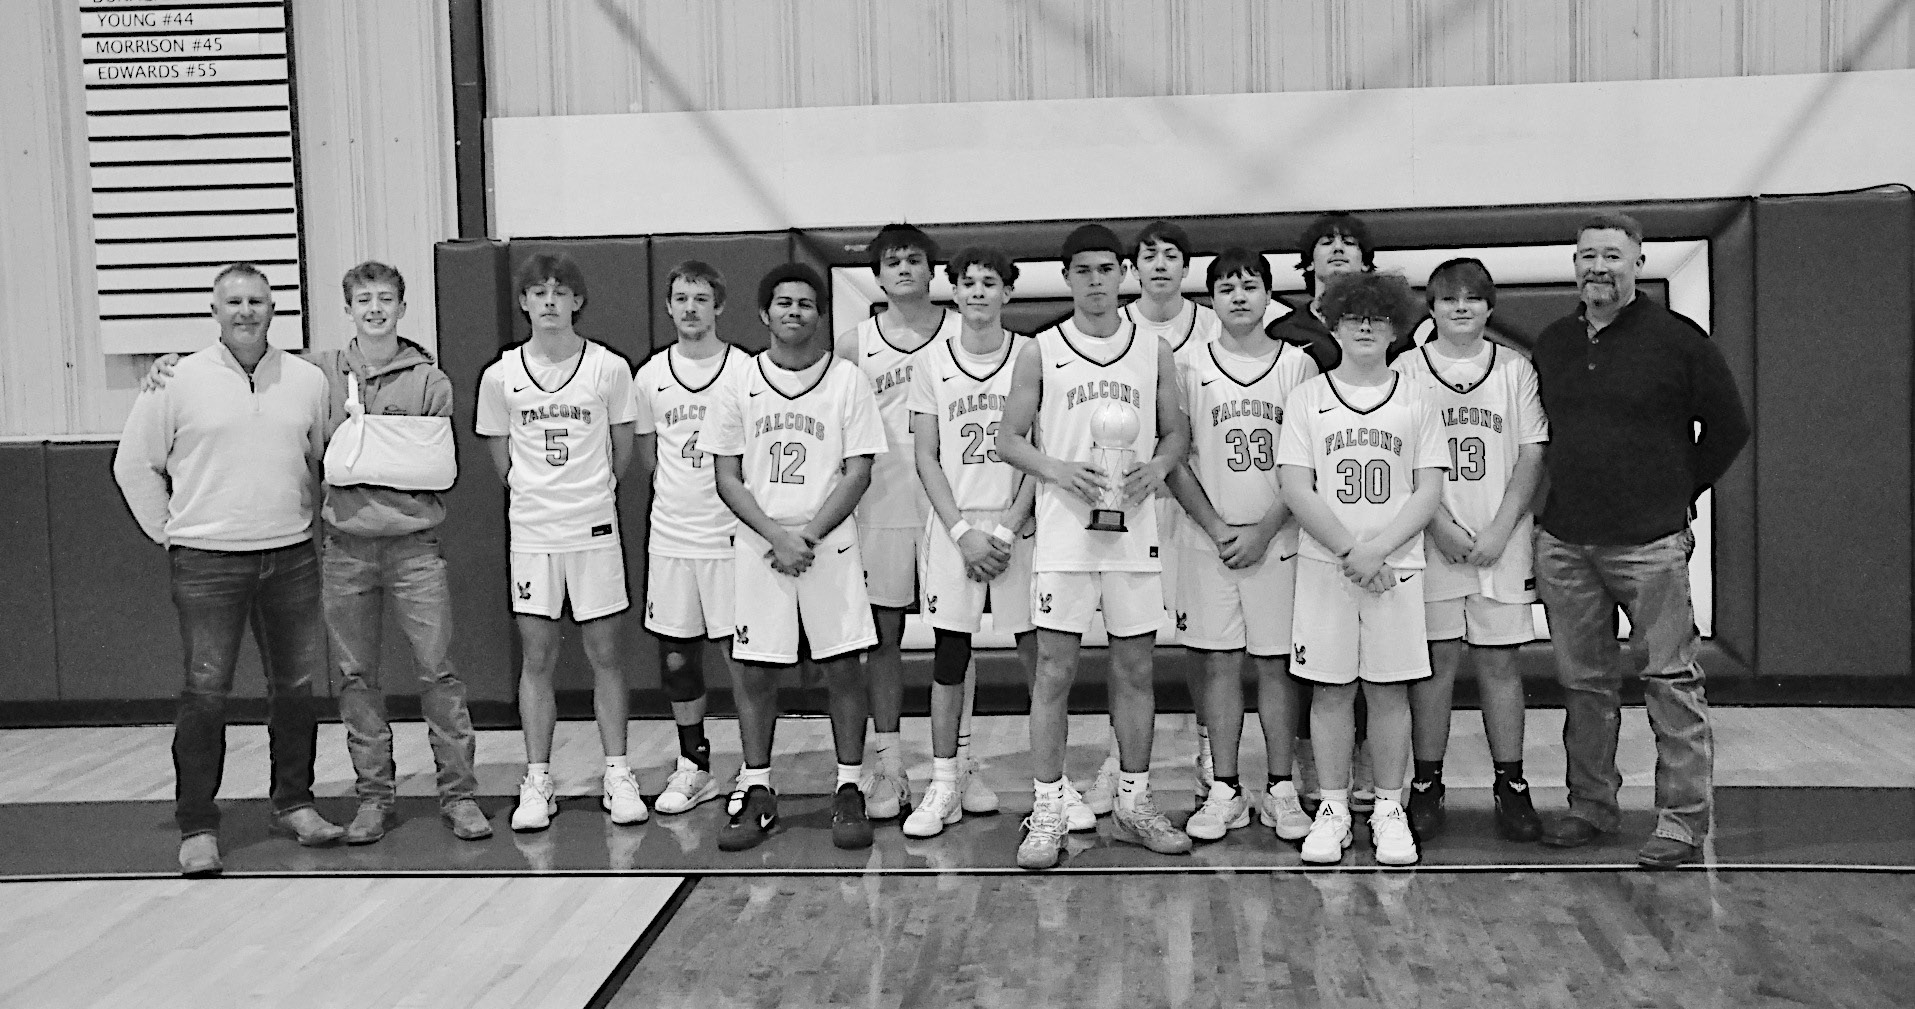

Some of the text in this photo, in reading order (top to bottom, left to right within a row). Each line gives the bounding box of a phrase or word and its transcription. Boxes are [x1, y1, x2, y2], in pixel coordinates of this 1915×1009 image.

[98, 12, 194, 27] YOUNG #44
[96, 37, 223, 54] MORRISON #45
[98, 62, 217, 80] EDWARDS #55
[1066, 380, 1140, 410] FALCONS
[521, 404, 591, 425] FALCONS
[755, 412, 825, 441] FALCONS
[1211, 399, 1284, 427] FALCONS
[1441, 406, 1503, 434] LCONS
[545, 428, 569, 466] 5
[681, 430, 704, 468] 4
[1225, 428, 1274, 472] 33
[1325, 427, 1402, 456] FALCONS
[770, 442, 807, 484] 12
[1447, 437, 1486, 482] 13
[1336, 459, 1391, 504] 30
